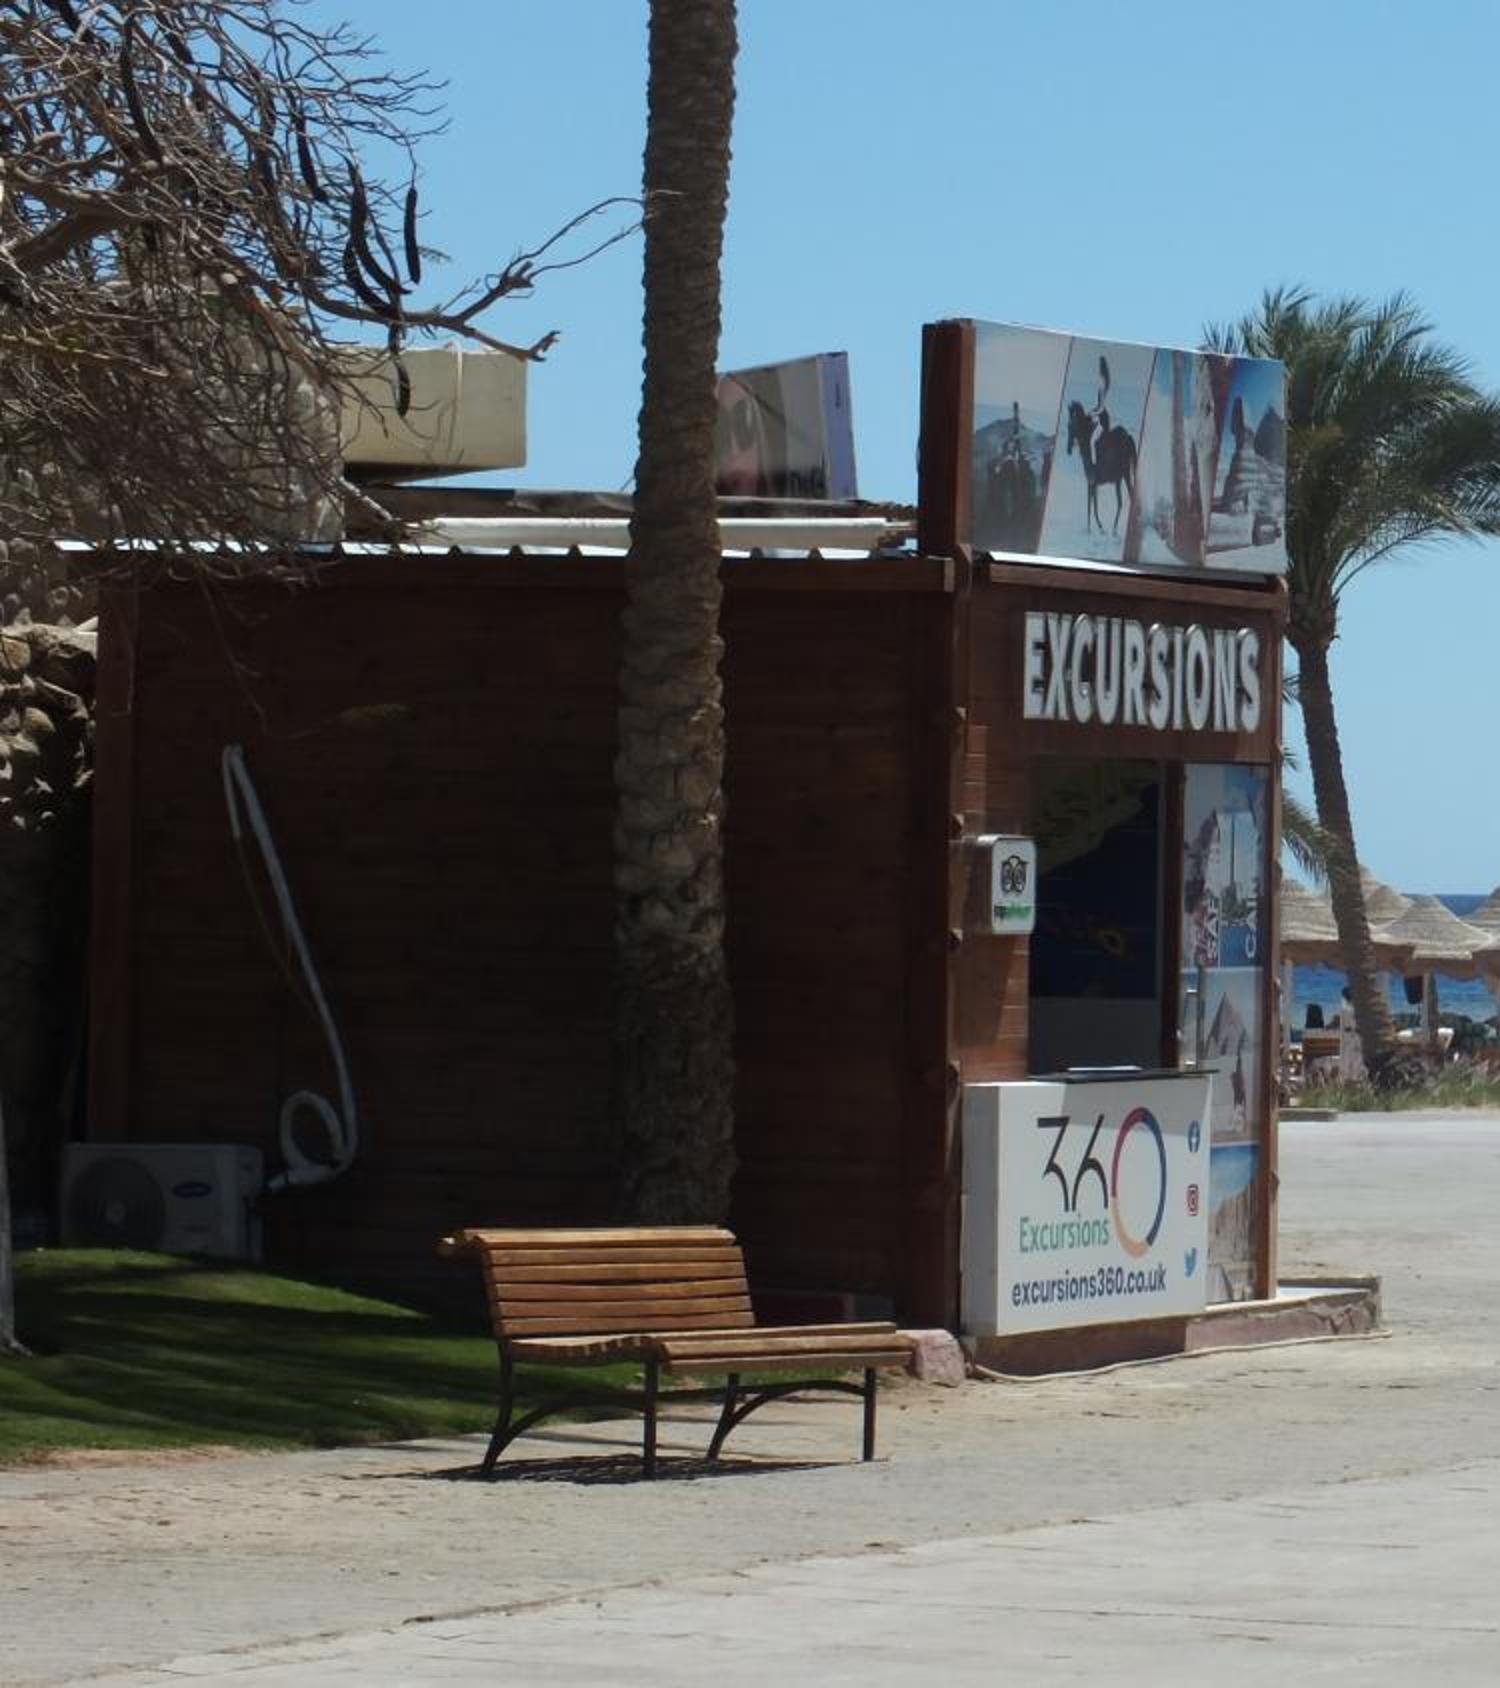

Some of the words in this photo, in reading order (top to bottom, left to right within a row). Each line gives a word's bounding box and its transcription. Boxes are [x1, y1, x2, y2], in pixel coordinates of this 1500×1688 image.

[1023, 611, 1260, 732] EXCURSIONS
[1037, 1107, 1167, 1257] 360
[1019, 1212, 1109, 1254] Excursions
[1012, 1264, 1166, 1306] excursions360.co.uk
